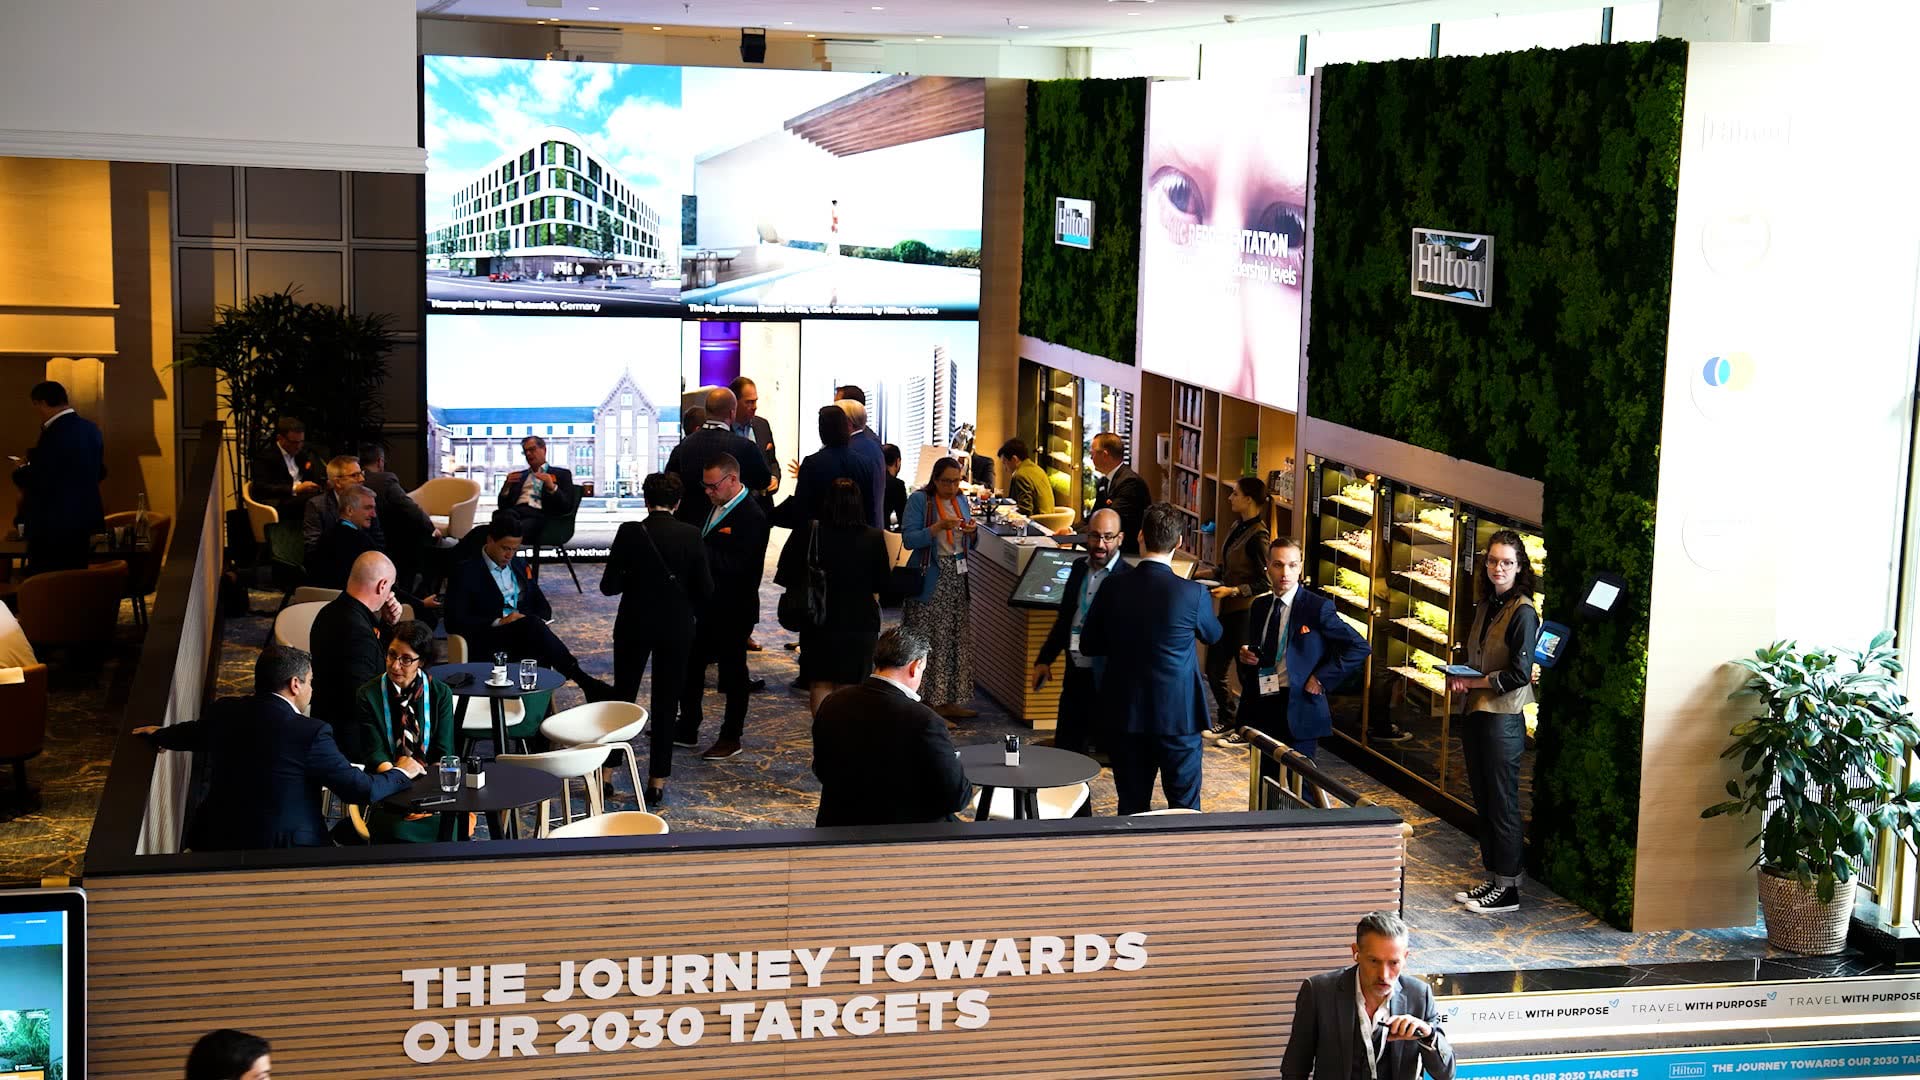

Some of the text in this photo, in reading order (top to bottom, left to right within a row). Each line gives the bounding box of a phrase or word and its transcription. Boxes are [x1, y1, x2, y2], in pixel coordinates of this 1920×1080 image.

[1058, 207, 1089, 238] Hilton
[1271, 262, 1297, 286] levels
[1417, 243, 1483, 290] Hilton
[559, 302, 601, 312] Germany
[688, 304, 705, 312] The
[402, 932, 1148, 1010] THE JOURNEY TOWARDS
[1631, 999, 1767, 1013] TRAVEL WITH PURPOSE
[1789, 992, 1920, 1006] TRAVEL WITH PURPOSE
[1471, 1006, 1610, 1021] TRAVEL WITH PURPOSE
[403, 989, 991, 1064] OUR 2030 TARGETS
[1559, 1071, 1585, 1080] 2030
[1588, 1068, 1638, 1078] TARGETS
[1672, 1064, 1703, 1076] Hilton
[1712, 1064, 1733, 1073] THE
[1735, 1062, 1788, 1072] JOURNEY
[1790, 1059, 1845, 1070] TOWARDS
[1848, 1057, 1871, 1067] OUR
[1873, 1055, 1899, 1066] 2030
